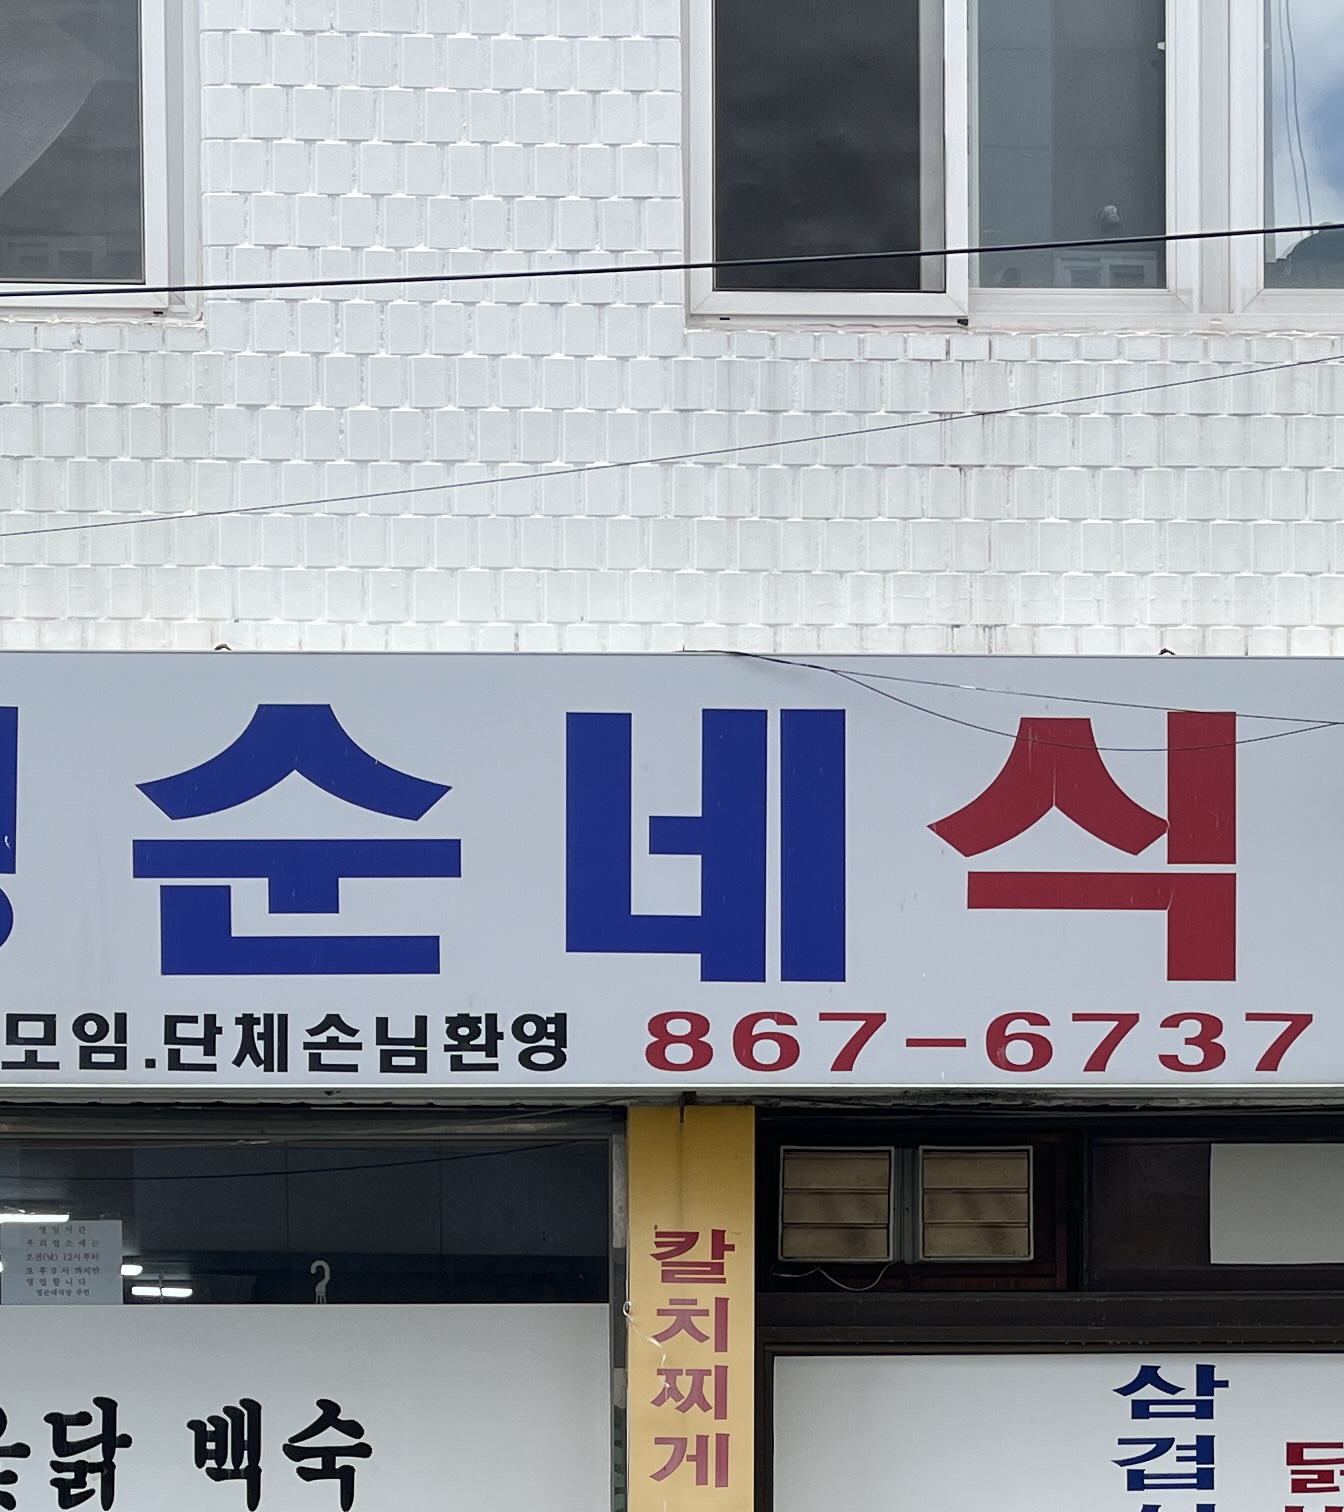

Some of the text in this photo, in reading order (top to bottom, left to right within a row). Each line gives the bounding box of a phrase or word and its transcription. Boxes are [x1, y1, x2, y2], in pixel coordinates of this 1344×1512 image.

[644, 1011, 1315, 1074] 867-6737
[649, 1228, 735, 1489] 칼치찌게
[186, 1396, 373, 1512] 백숙
